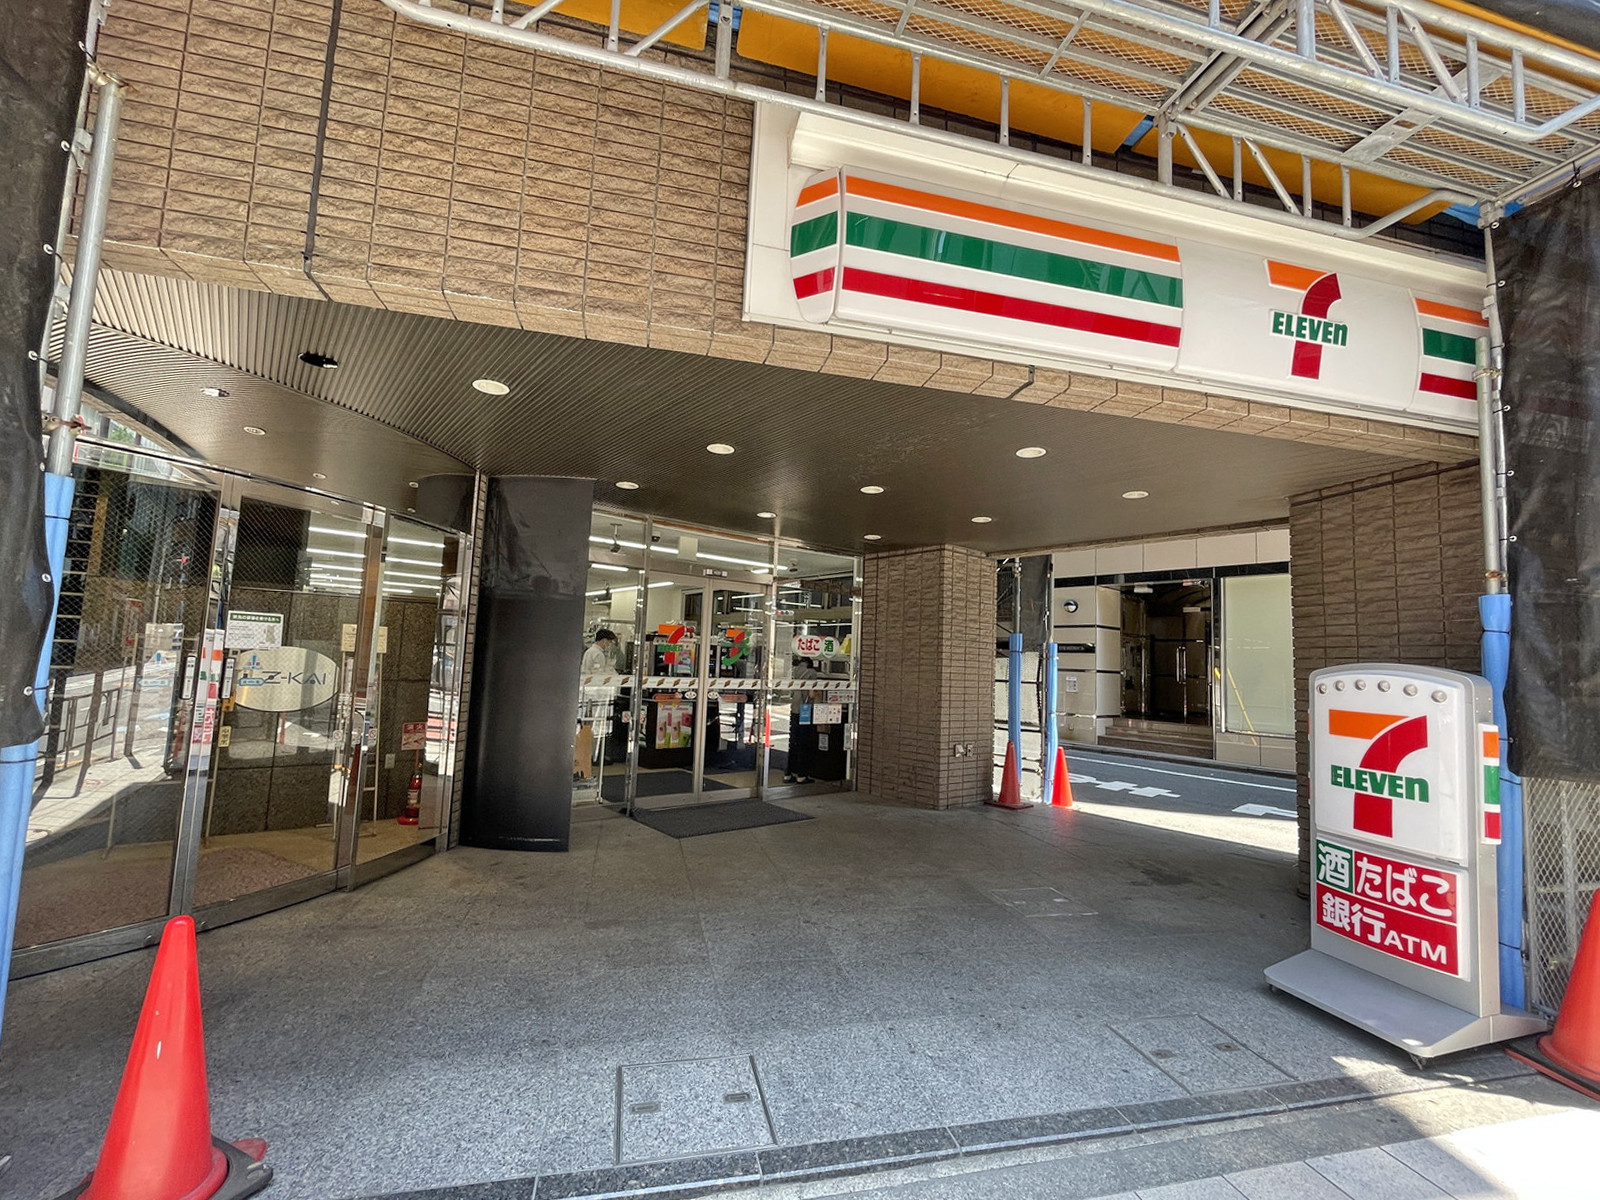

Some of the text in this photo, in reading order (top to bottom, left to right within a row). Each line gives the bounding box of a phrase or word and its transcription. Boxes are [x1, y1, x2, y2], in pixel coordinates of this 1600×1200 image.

[797, 637, 821, 652] たばこ
[824, 639, 834, 652] 酒
[262, 670, 327, 685] Z-KAI
[1318, 843, 1351, 889] 酒
[1357, 857, 1452, 917] たばこ
